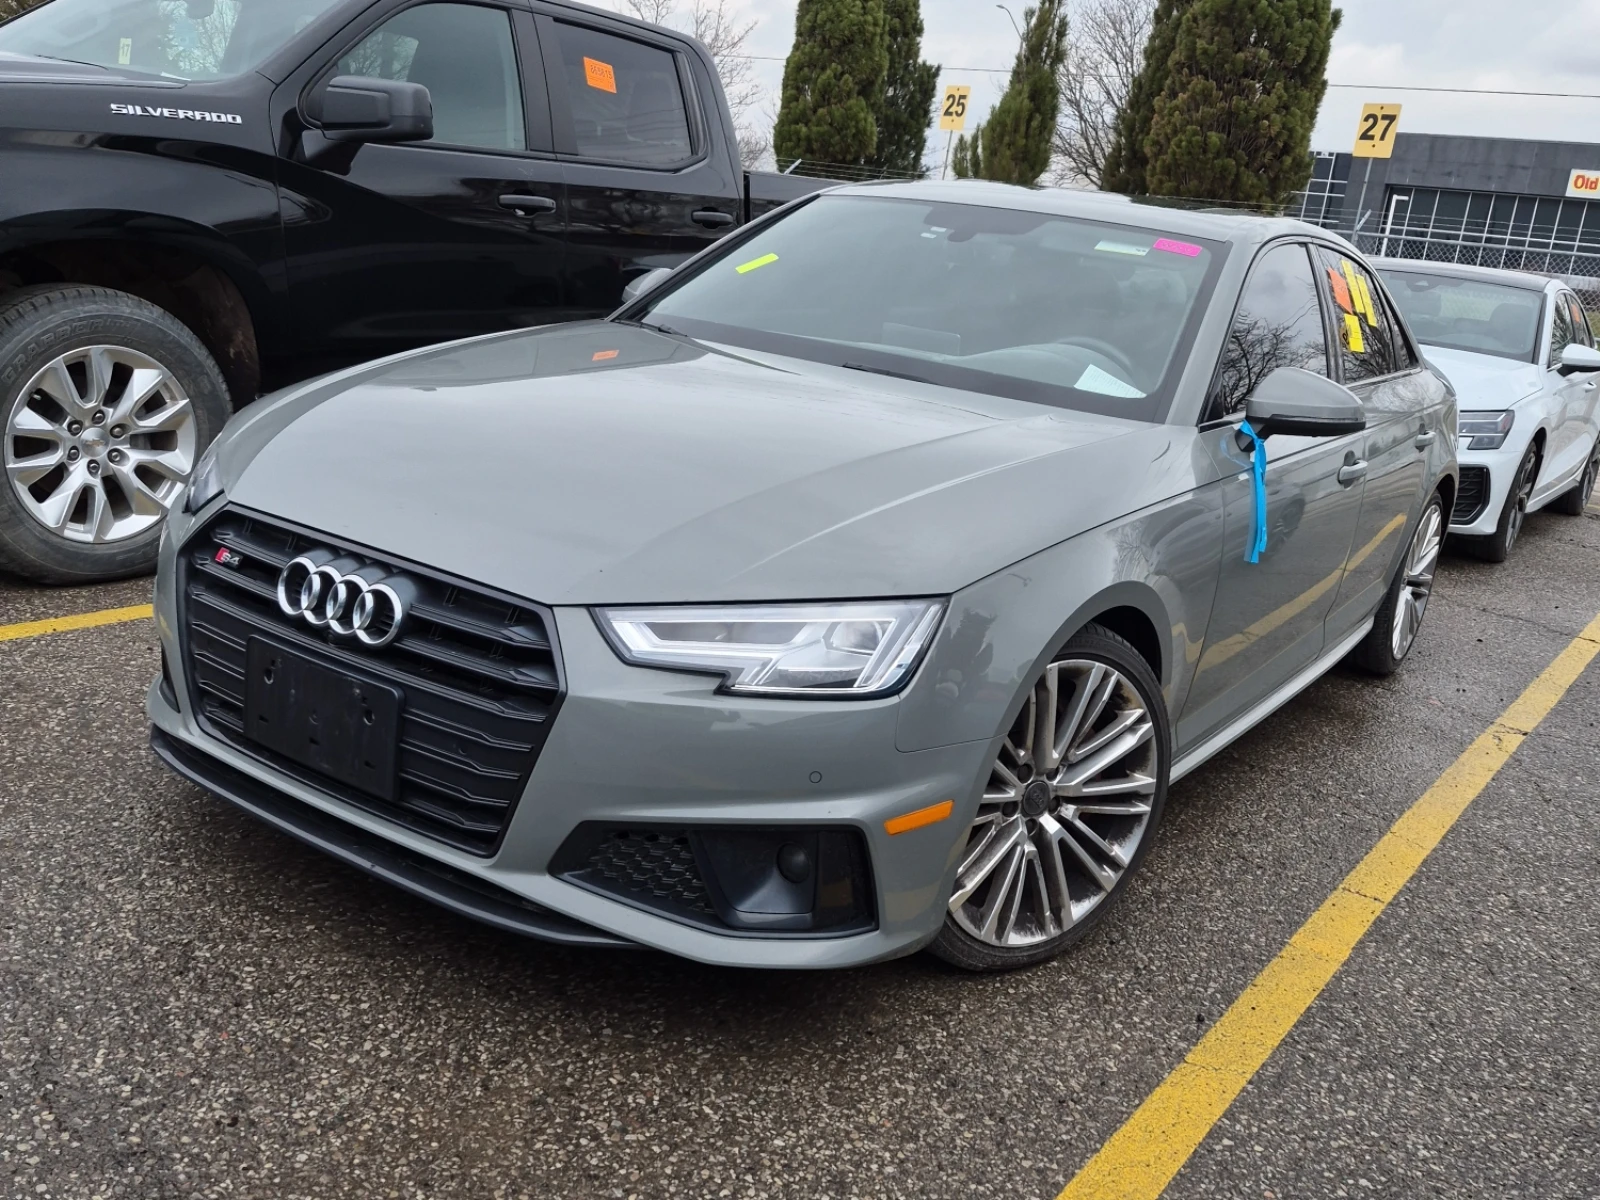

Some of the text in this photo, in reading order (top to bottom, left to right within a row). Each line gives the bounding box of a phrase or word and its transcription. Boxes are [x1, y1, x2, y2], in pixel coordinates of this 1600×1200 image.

[110, 103, 243, 124] SILVERADO
[943, 93, 968, 117] 25
[1358, 112, 1398, 142] 27
[1573, 174, 1600, 191] Old
[219, 550, 240, 565] S4
